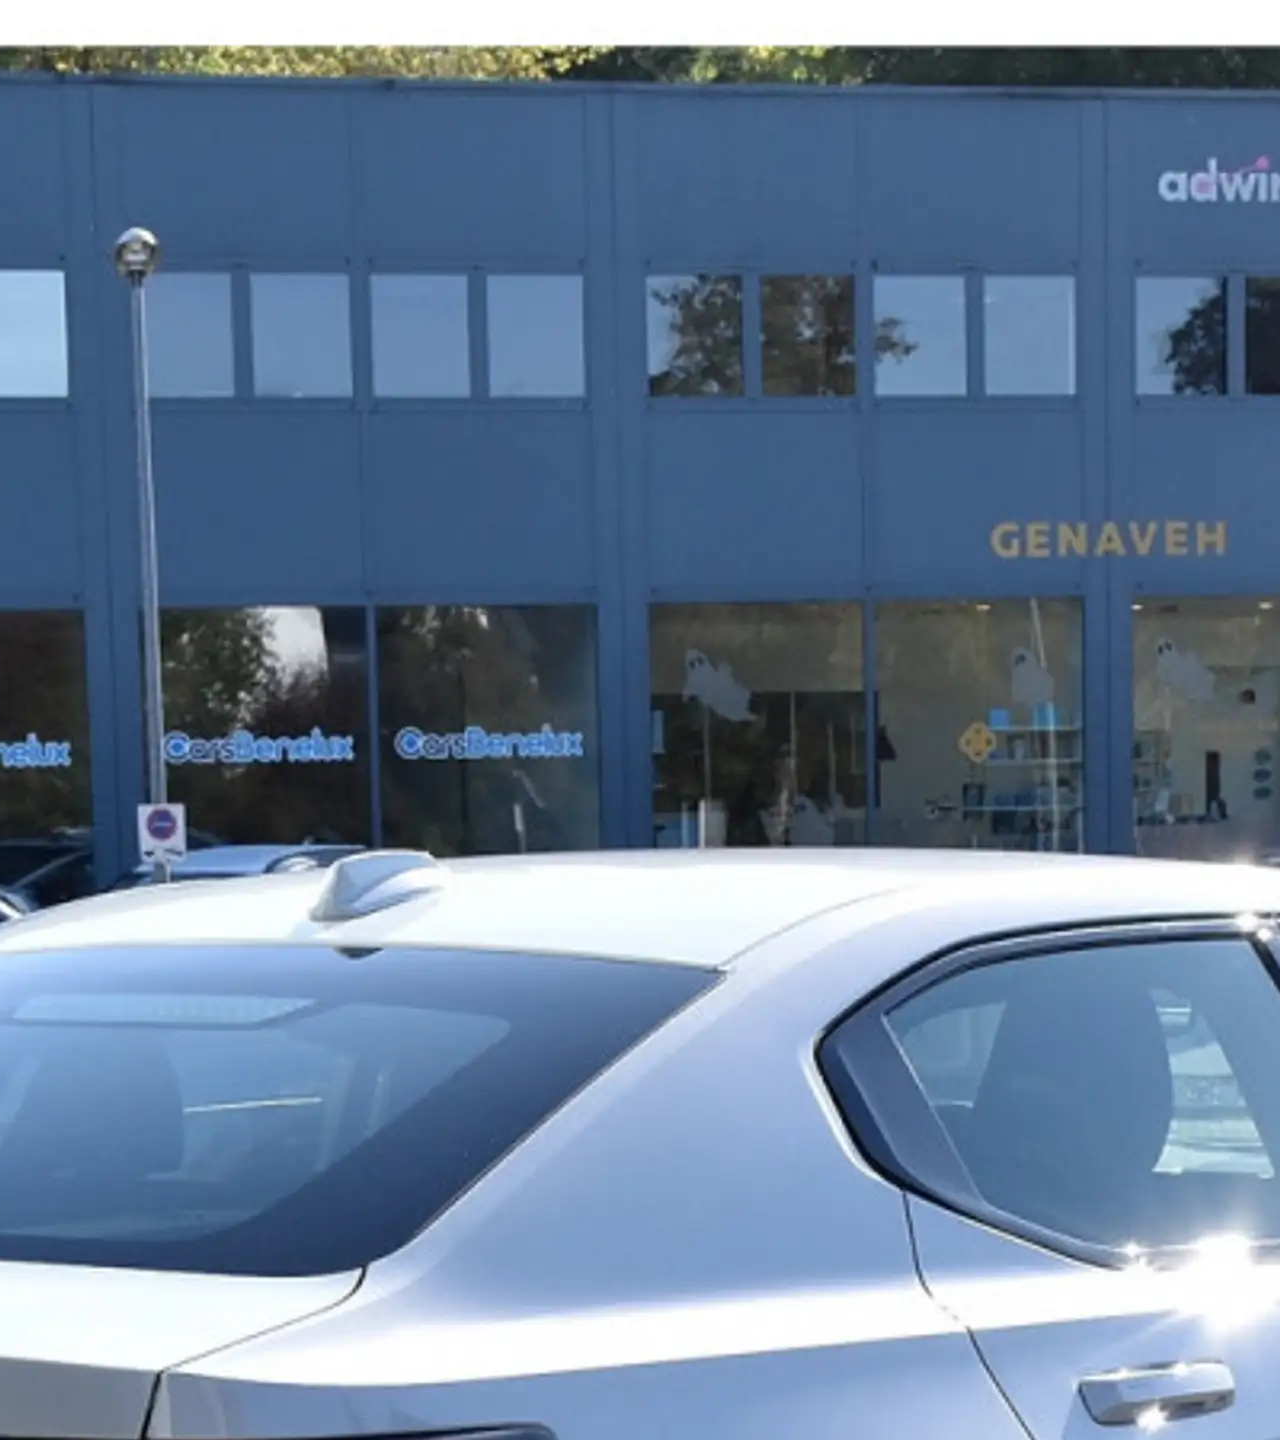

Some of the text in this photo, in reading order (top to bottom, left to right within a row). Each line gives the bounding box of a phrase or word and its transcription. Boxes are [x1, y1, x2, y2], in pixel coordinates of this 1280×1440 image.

[990, 520, 1229, 559] GENAVEH
[164, 726, 355, 765] CarsBenelux
[394, 723, 583, 760] CarsBenelux
